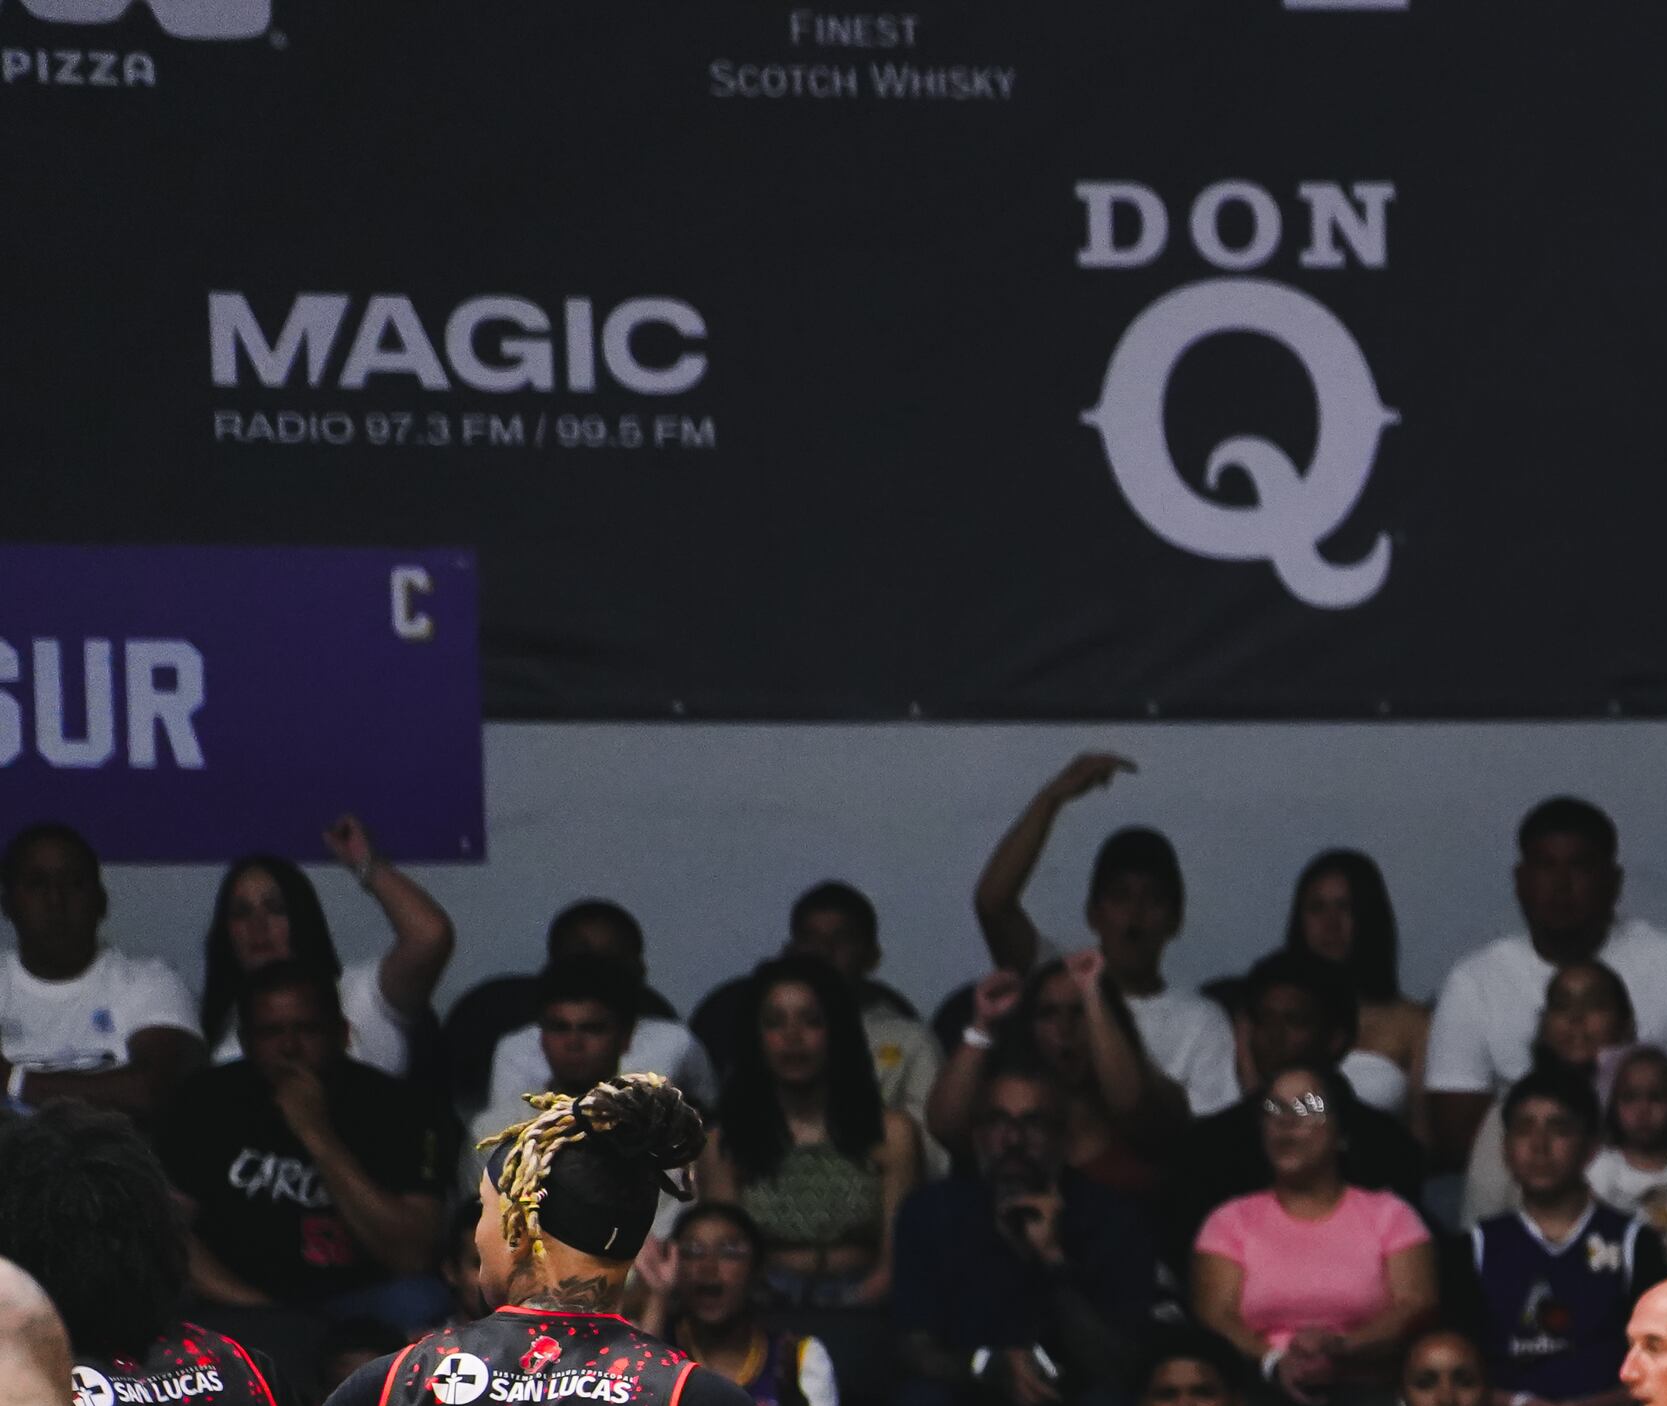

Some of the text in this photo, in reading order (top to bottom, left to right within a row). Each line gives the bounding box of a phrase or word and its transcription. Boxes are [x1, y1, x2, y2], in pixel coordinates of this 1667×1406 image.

[2, 49, 155, 86] PIZZA
[1075, 181, 1395, 269] DON
[208, 292, 708, 395] MAGIC
[213, 412, 355, 446] RADIO
[365, 413, 451, 447] 97.3
[462, 414, 525, 446] FM
[653, 416, 717, 449] FM
[1081, 278, 1400, 609] Q
[390, 567, 432, 640] C
[114, 1382, 153, 1405] SAN
[153, 1370, 224, 1403] LUCAS
[489, 1375, 632, 1404] SAN LUCAS
